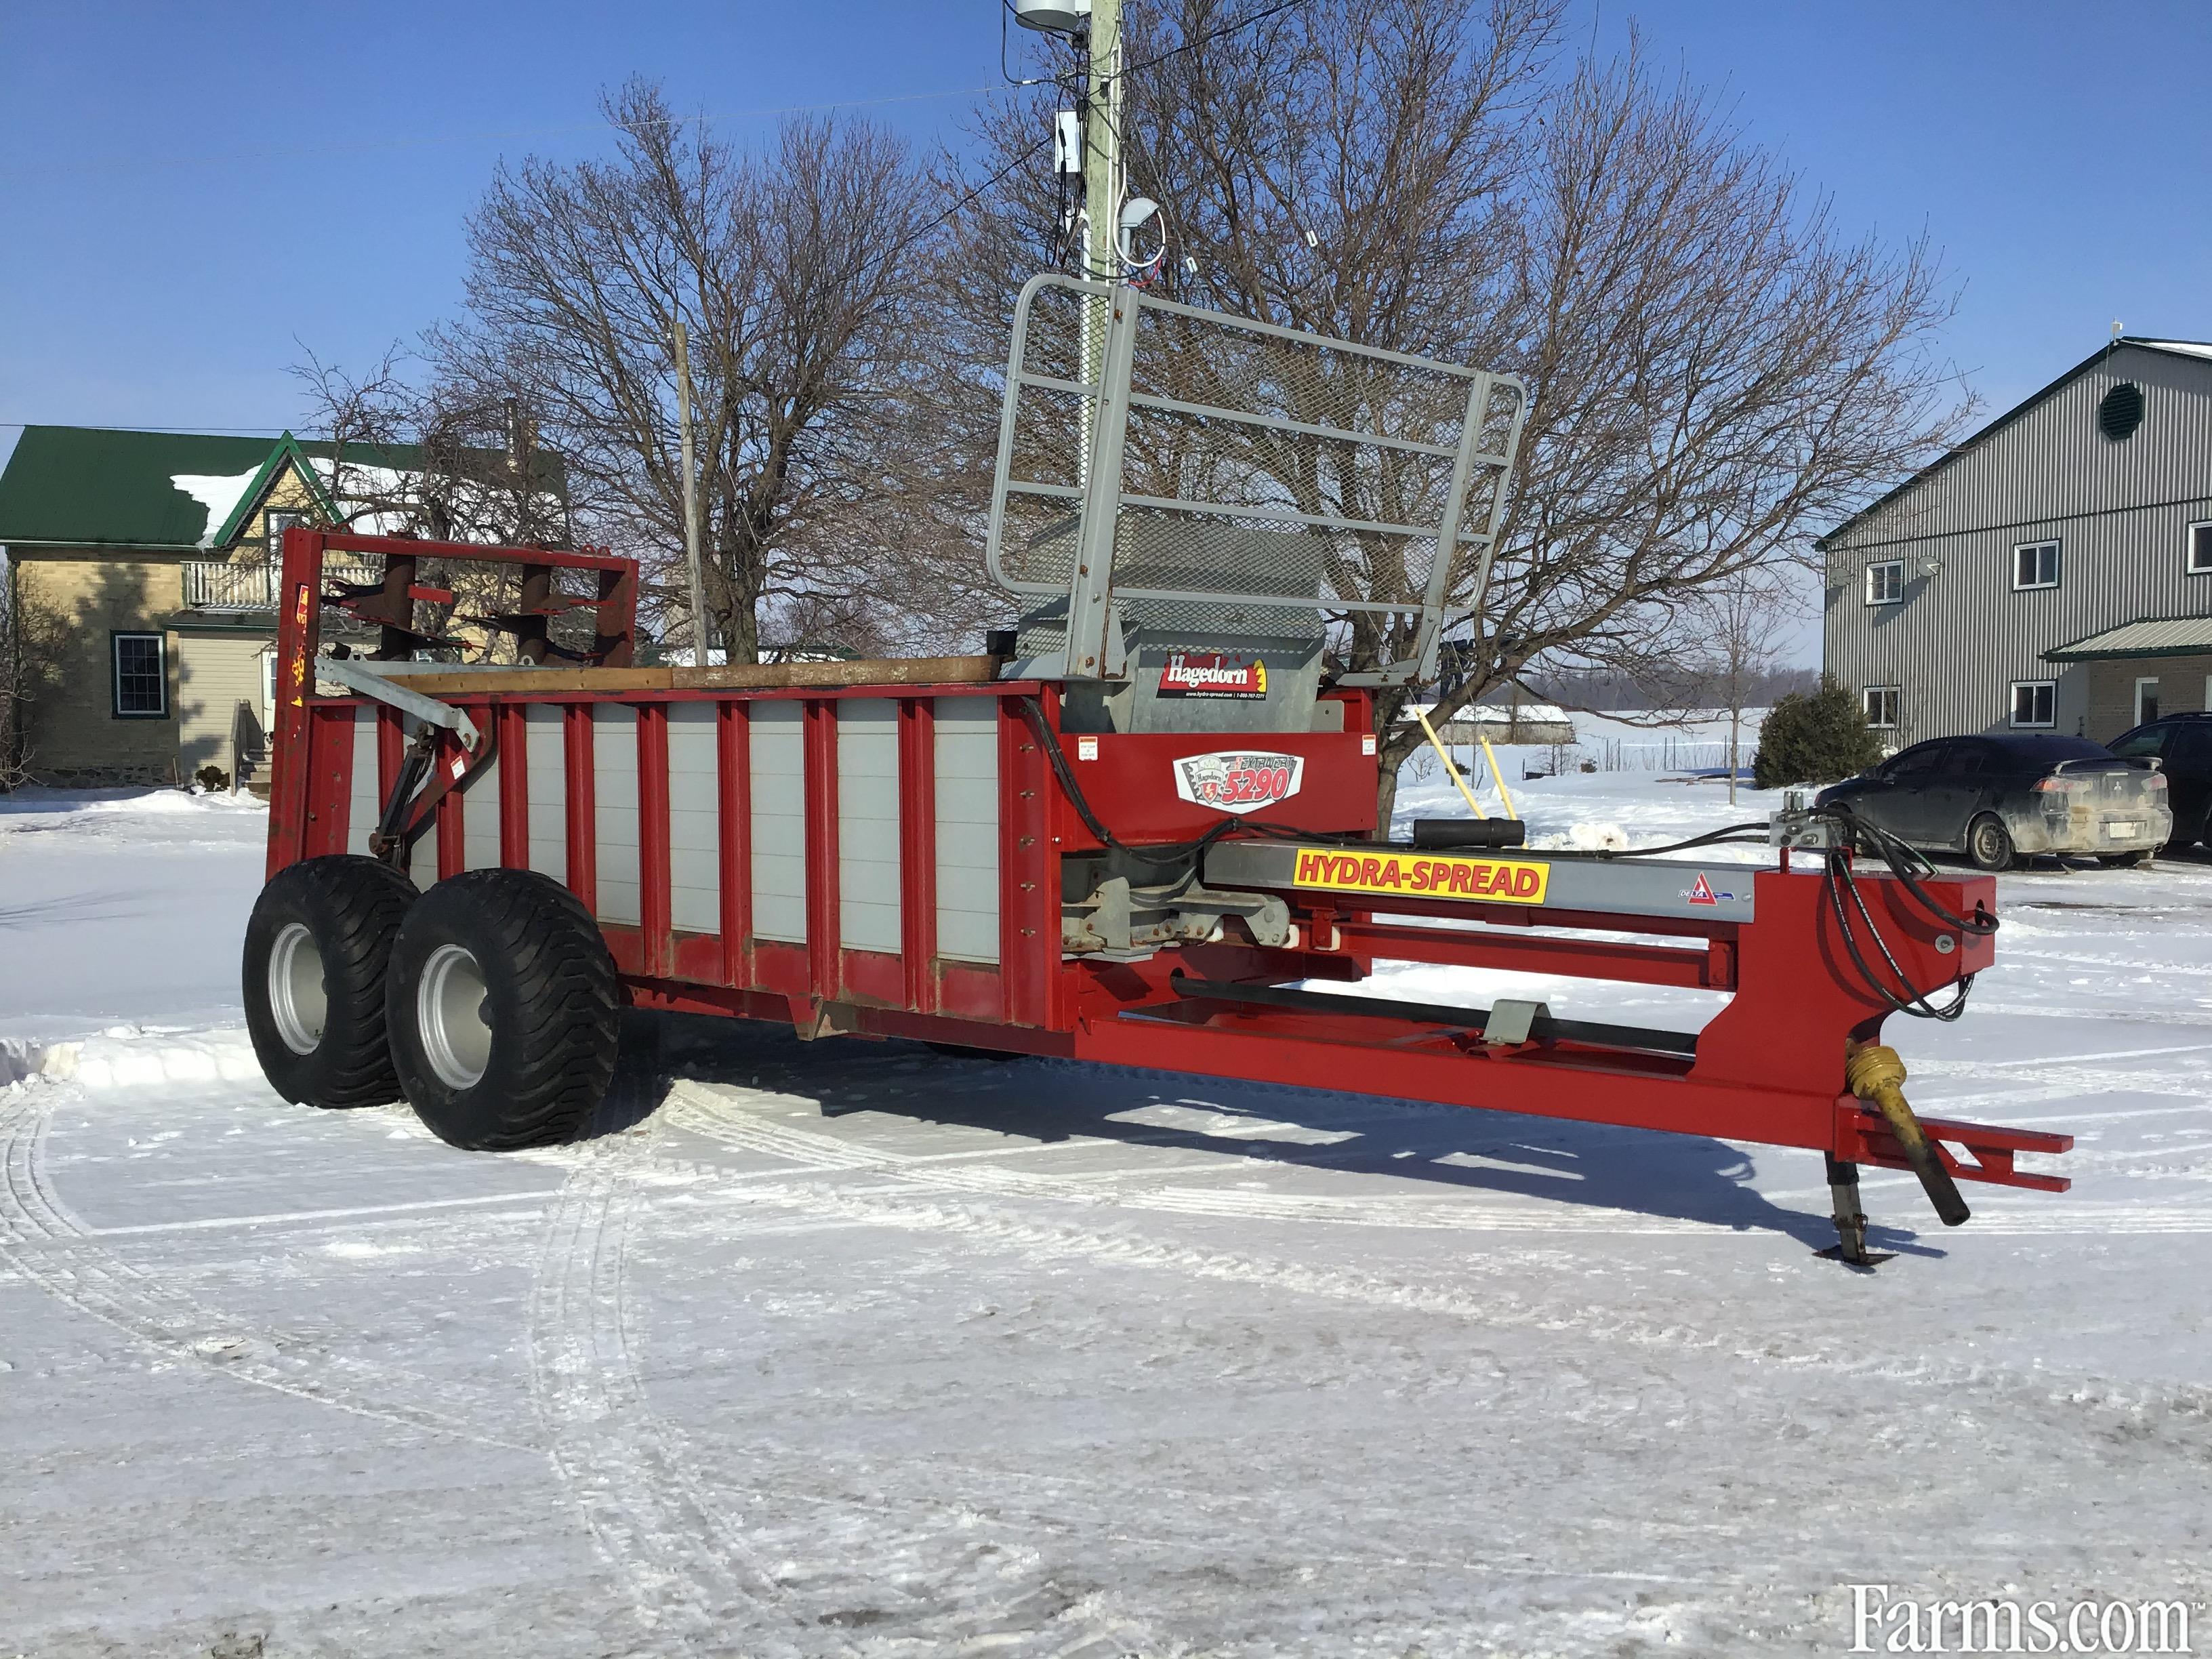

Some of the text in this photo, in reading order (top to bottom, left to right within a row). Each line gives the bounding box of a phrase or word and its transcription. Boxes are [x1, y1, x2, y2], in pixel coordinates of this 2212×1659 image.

[1167, 655, 1248, 688] Hagedorn
[1221, 767, 1289, 804] 5290
[1298, 854, 1540, 898] HYDRA-SPREAD
